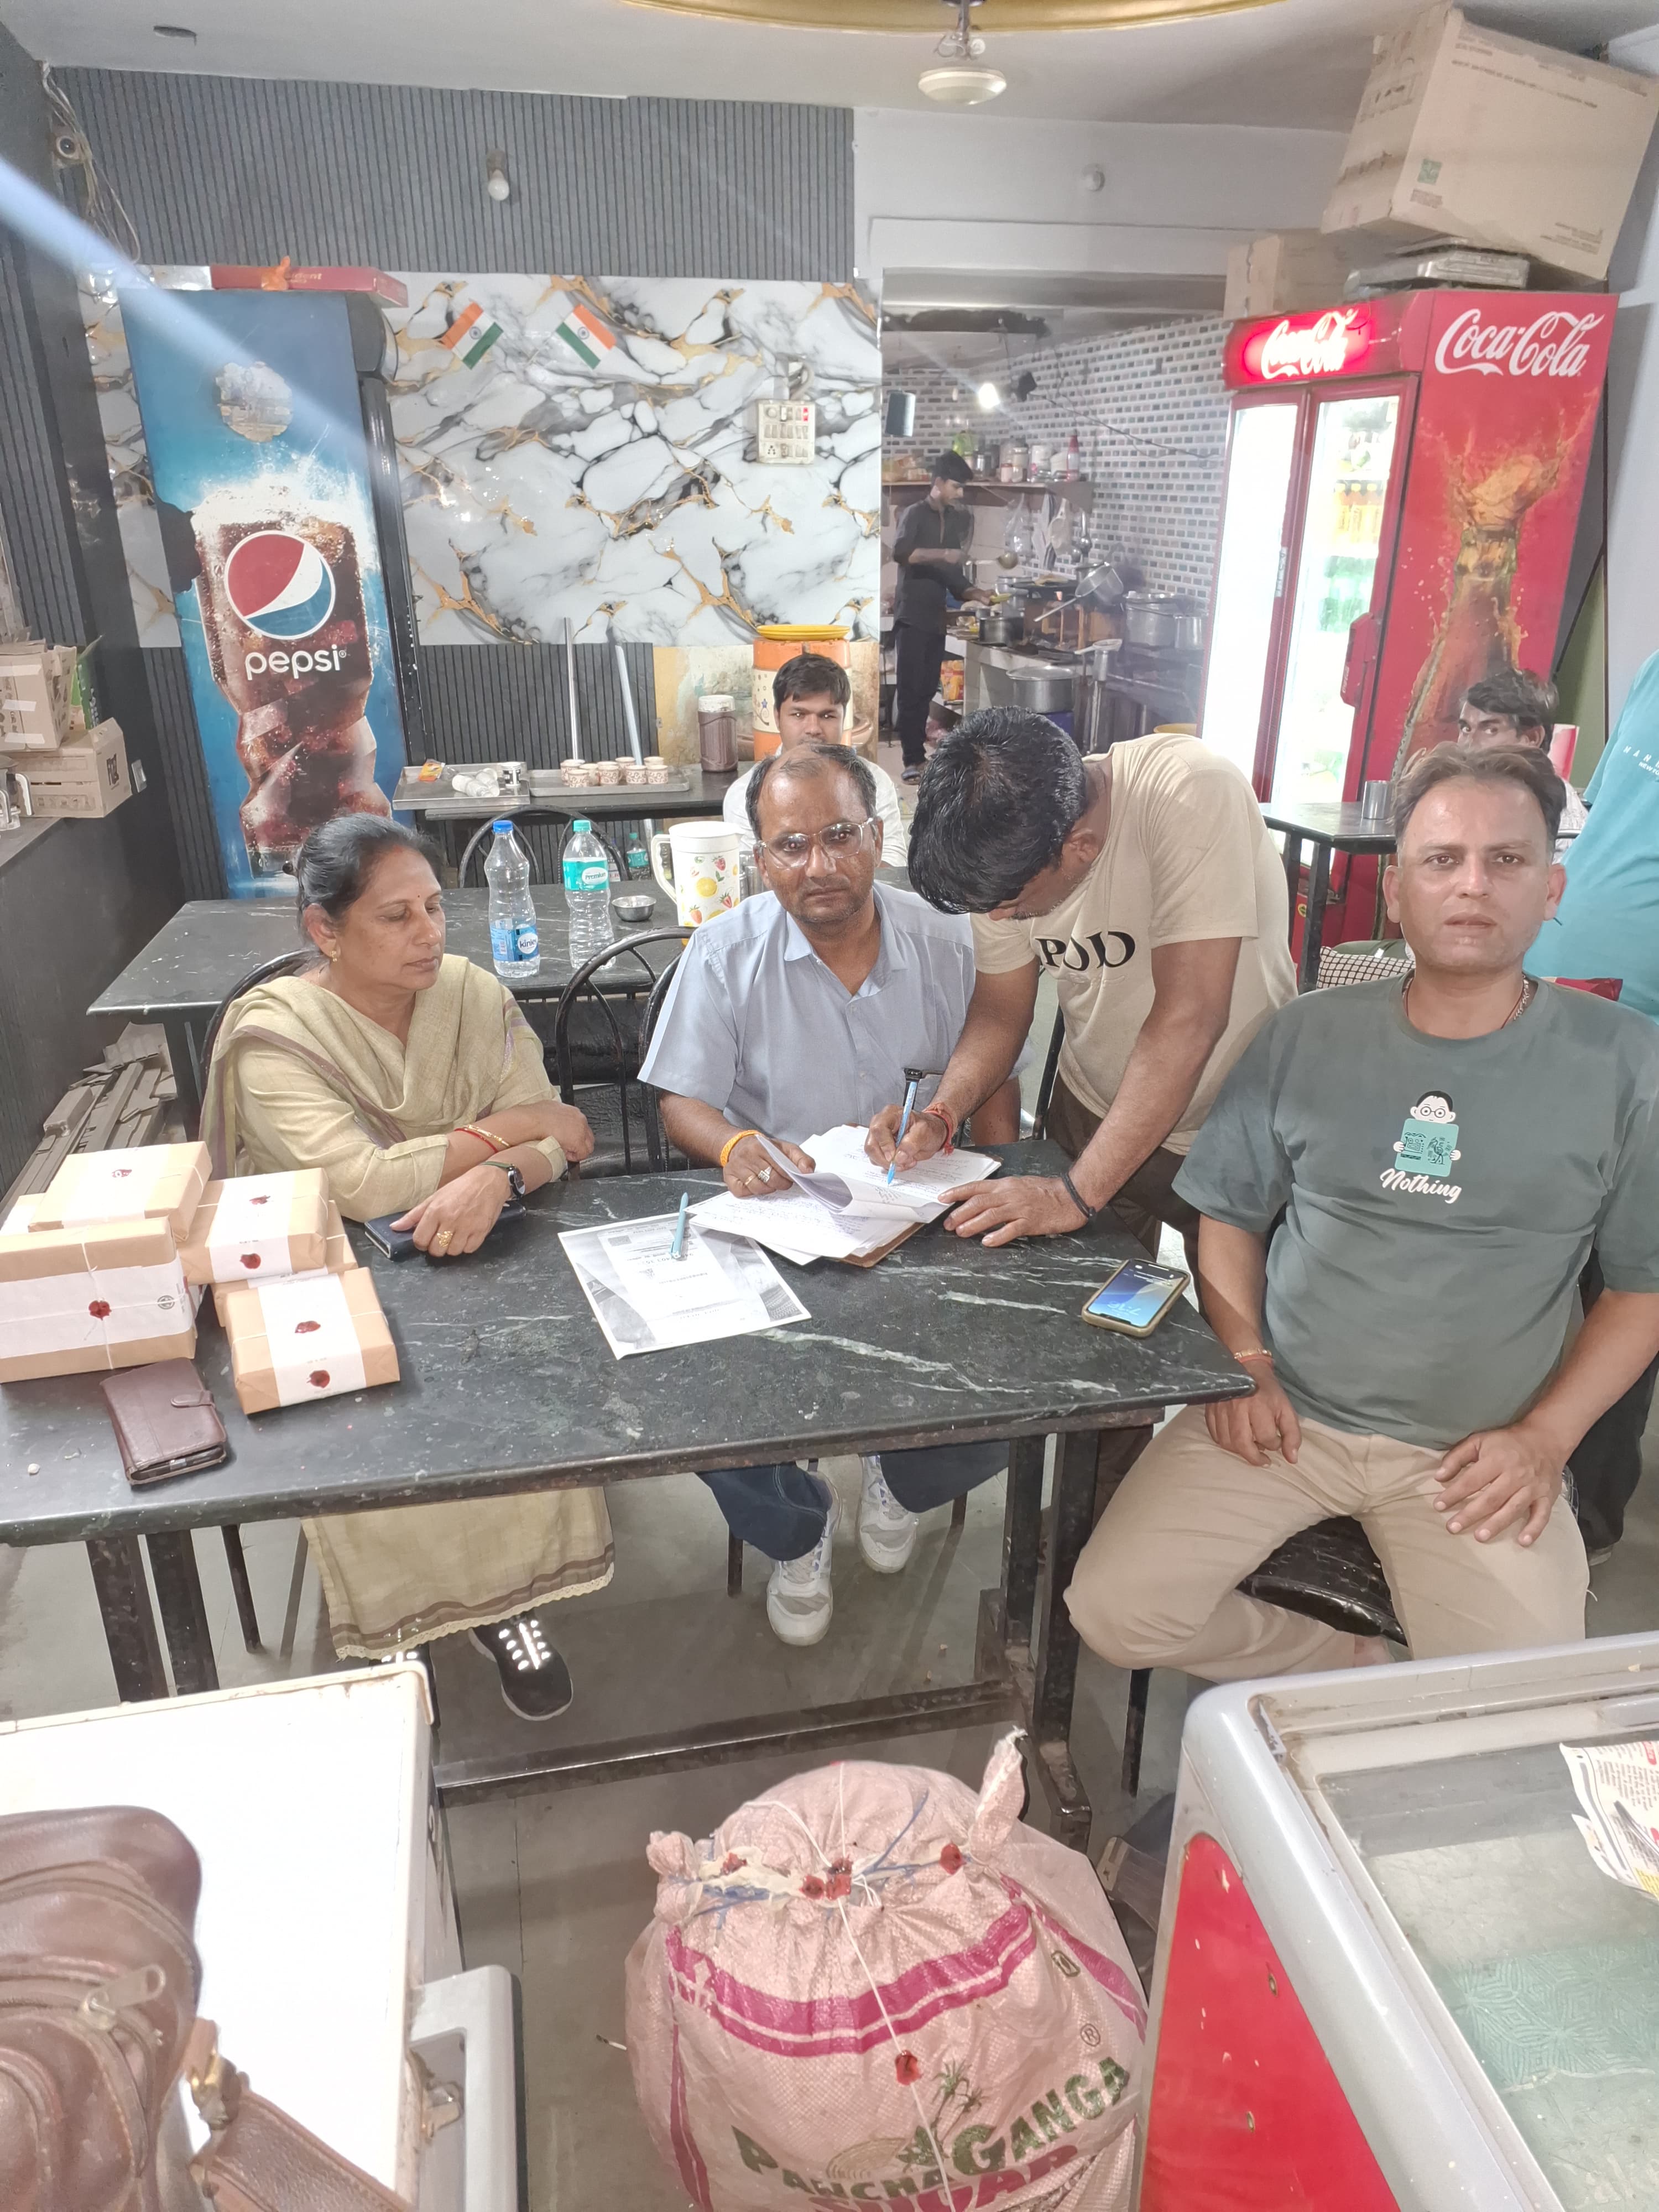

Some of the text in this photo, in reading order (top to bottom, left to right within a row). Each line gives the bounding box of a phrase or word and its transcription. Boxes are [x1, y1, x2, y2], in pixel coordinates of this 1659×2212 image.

[1434, 308, 1605, 377] Coca-Cola
[245, 644, 341, 681] pepsi
[1380, 1168, 1462, 1204] Nothing
